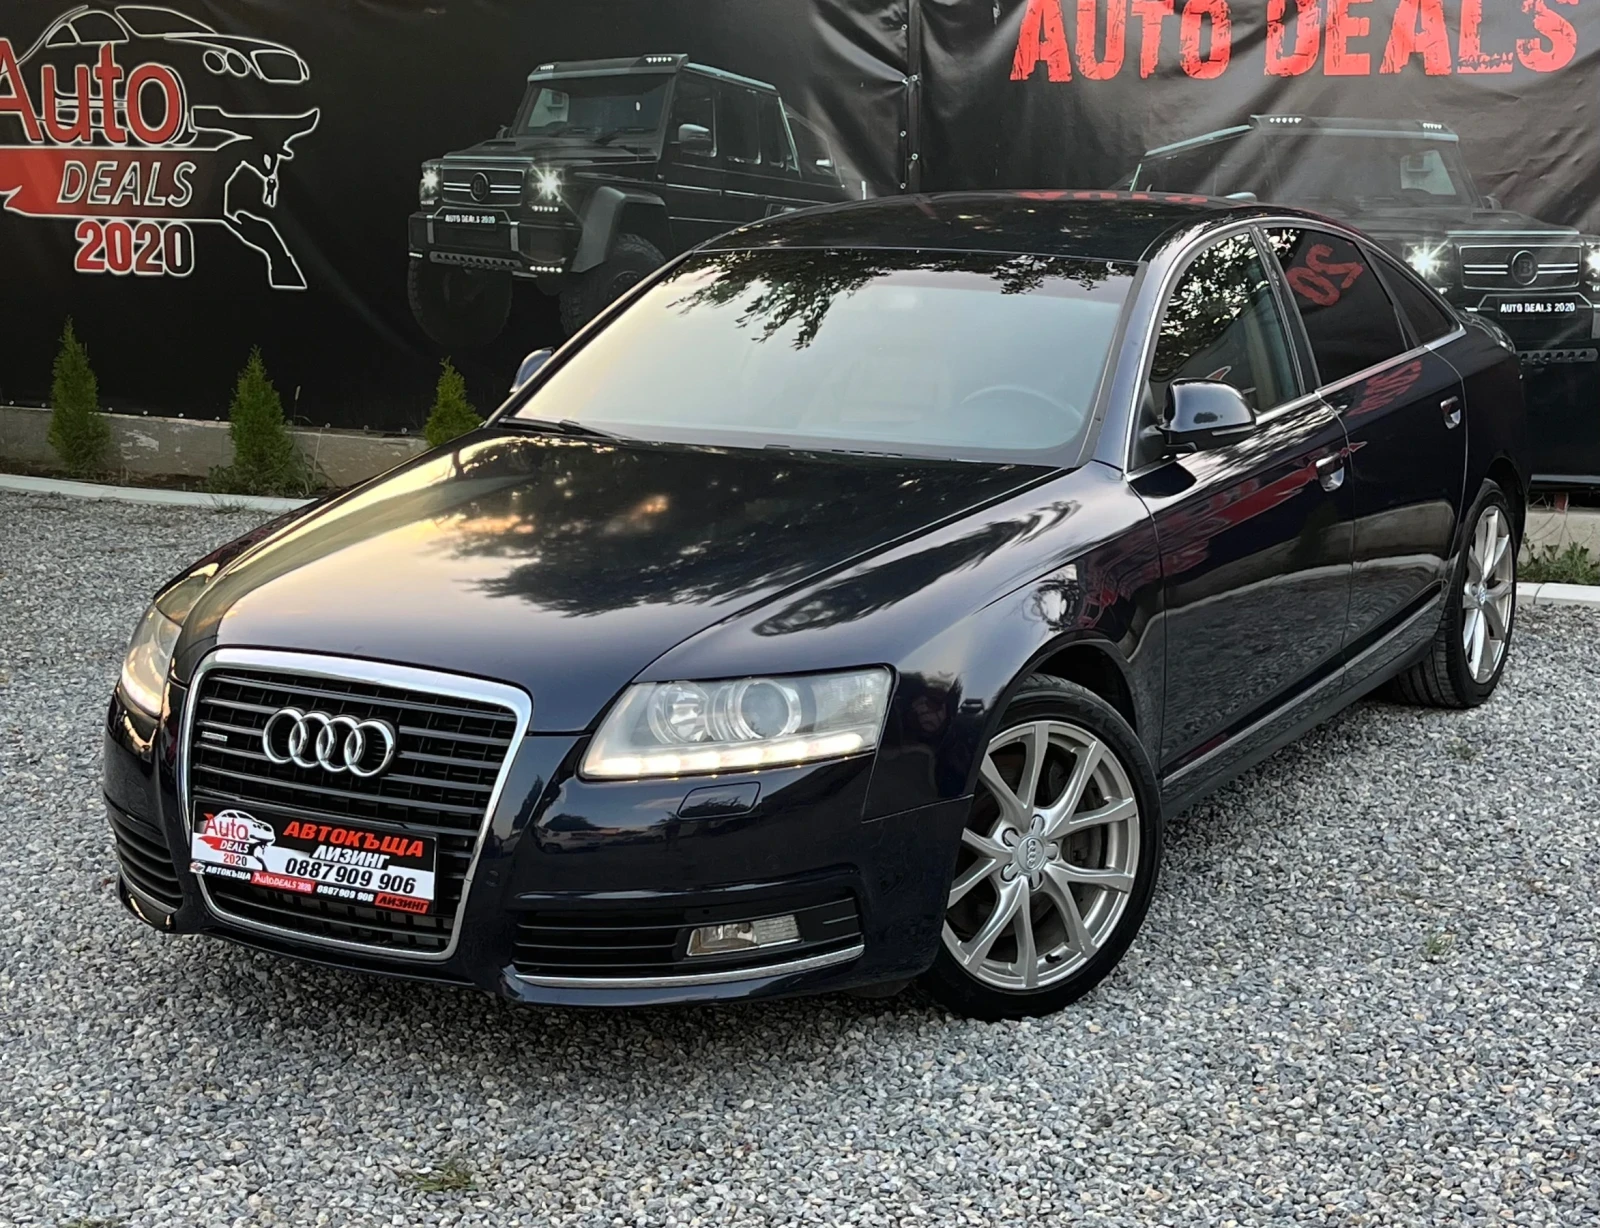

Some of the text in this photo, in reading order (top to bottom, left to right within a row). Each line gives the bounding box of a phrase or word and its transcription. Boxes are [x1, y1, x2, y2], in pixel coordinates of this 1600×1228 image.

[1010, 0, 1578, 83] AUTO DEALS
[56, 160, 197, 208] DEALS
[74, 219, 195, 276] 2020
[1500, 302, 1576, 313] AUTO DEALS 2020
[203, 814, 249, 841] Auto
[220, 840, 250, 853] DEALS
[283, 821, 424, 858] АВТОКЪЩА
[223, 853, 248, 867] 2020
[312, 844, 391, 869] ЛИЗИНГ
[206, 865, 251, 880] АВТОКЪЩА
[378, 873, 417, 894] 906
[378, 895, 429, 912] ЛИЗИНГ
